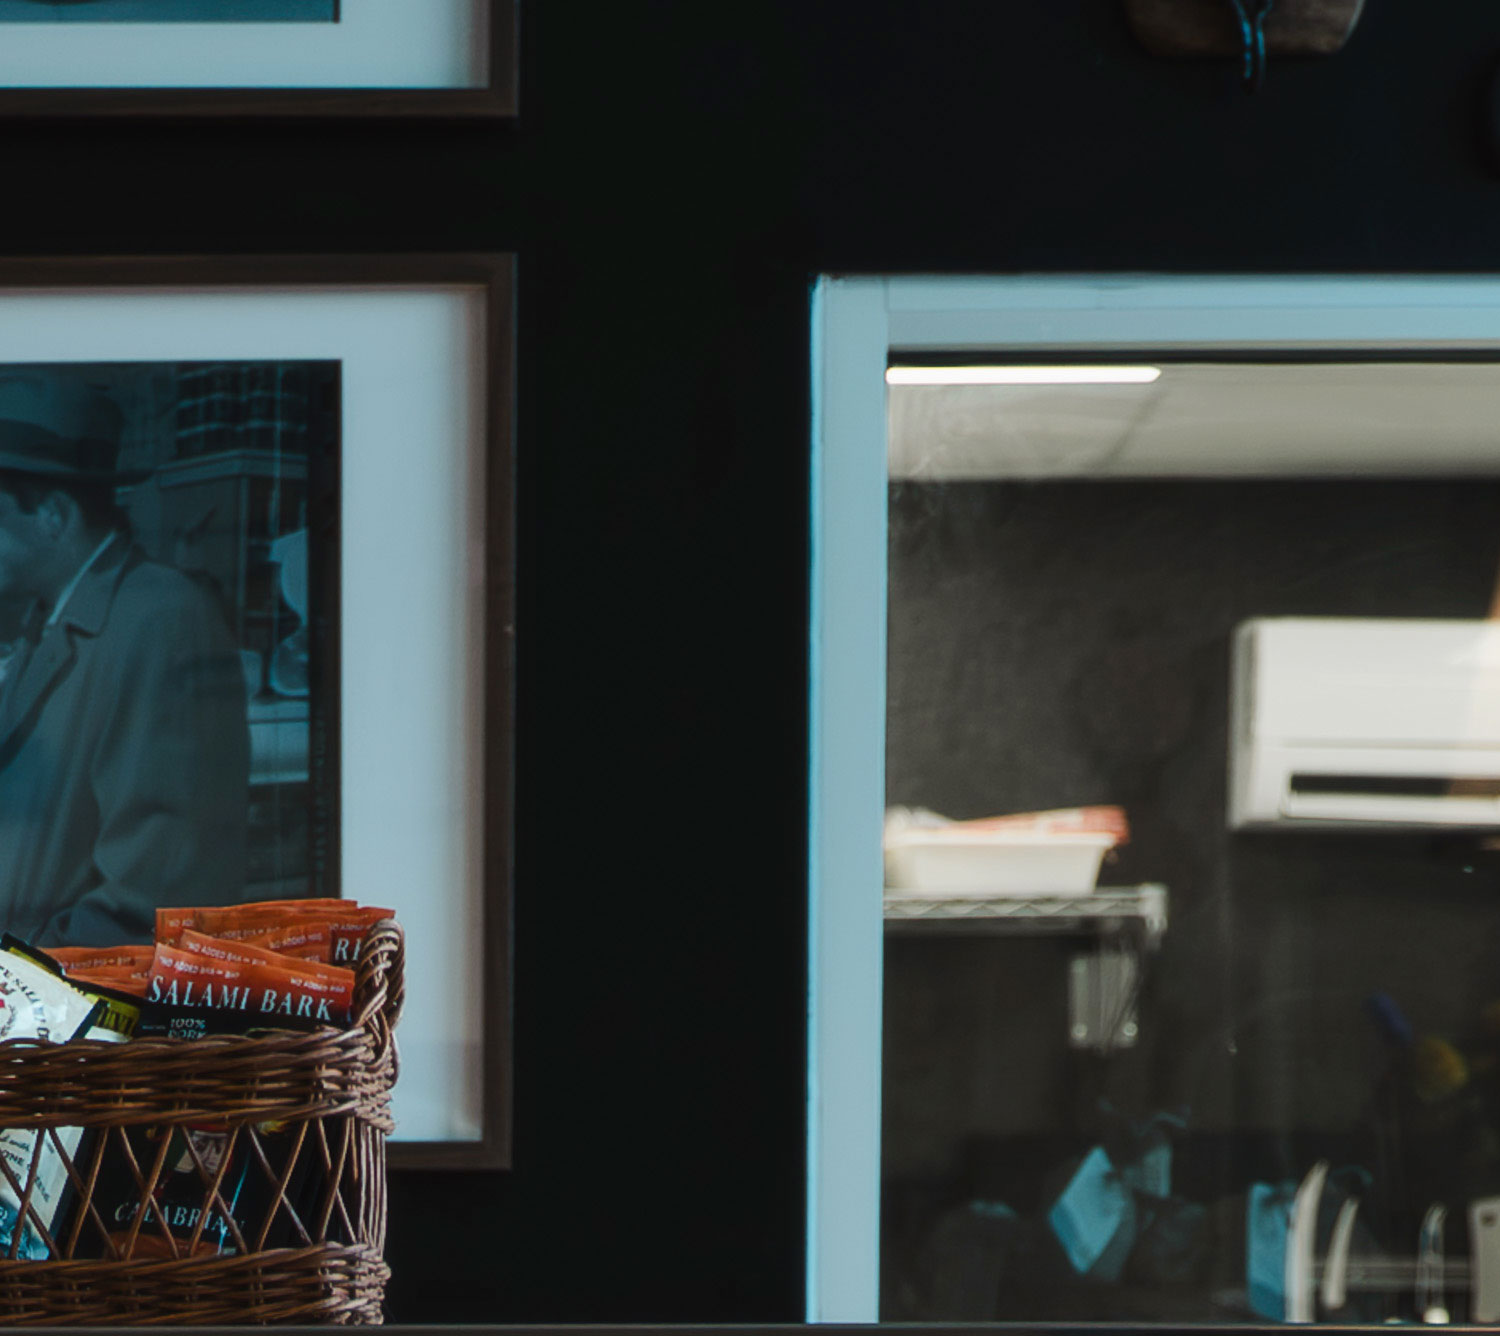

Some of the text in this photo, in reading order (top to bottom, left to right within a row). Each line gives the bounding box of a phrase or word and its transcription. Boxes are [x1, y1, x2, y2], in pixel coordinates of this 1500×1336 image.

[148, 974, 335, 1022] SALAMI BARK
[169, 1017, 207, 1030] 100%
